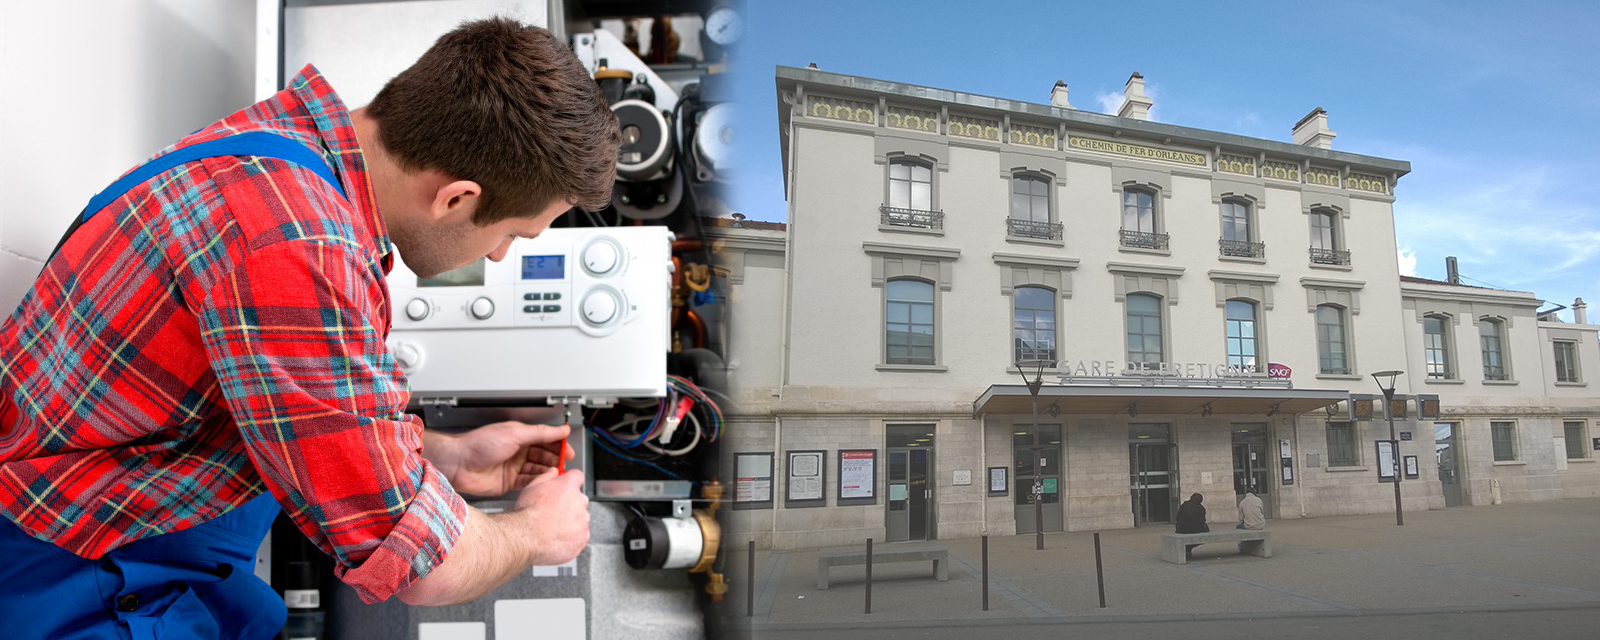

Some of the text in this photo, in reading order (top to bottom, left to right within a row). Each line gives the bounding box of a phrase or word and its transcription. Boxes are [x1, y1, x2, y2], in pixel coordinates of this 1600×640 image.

[1079, 139, 1114, 151] CHEMIN
[1116, 144, 1127, 153] DE
[1129, 146, 1146, 156] FER
[1056, 360, 1257, 378] GARE DE BRETIGNY
[1269, 368, 1290, 377] SNCF
